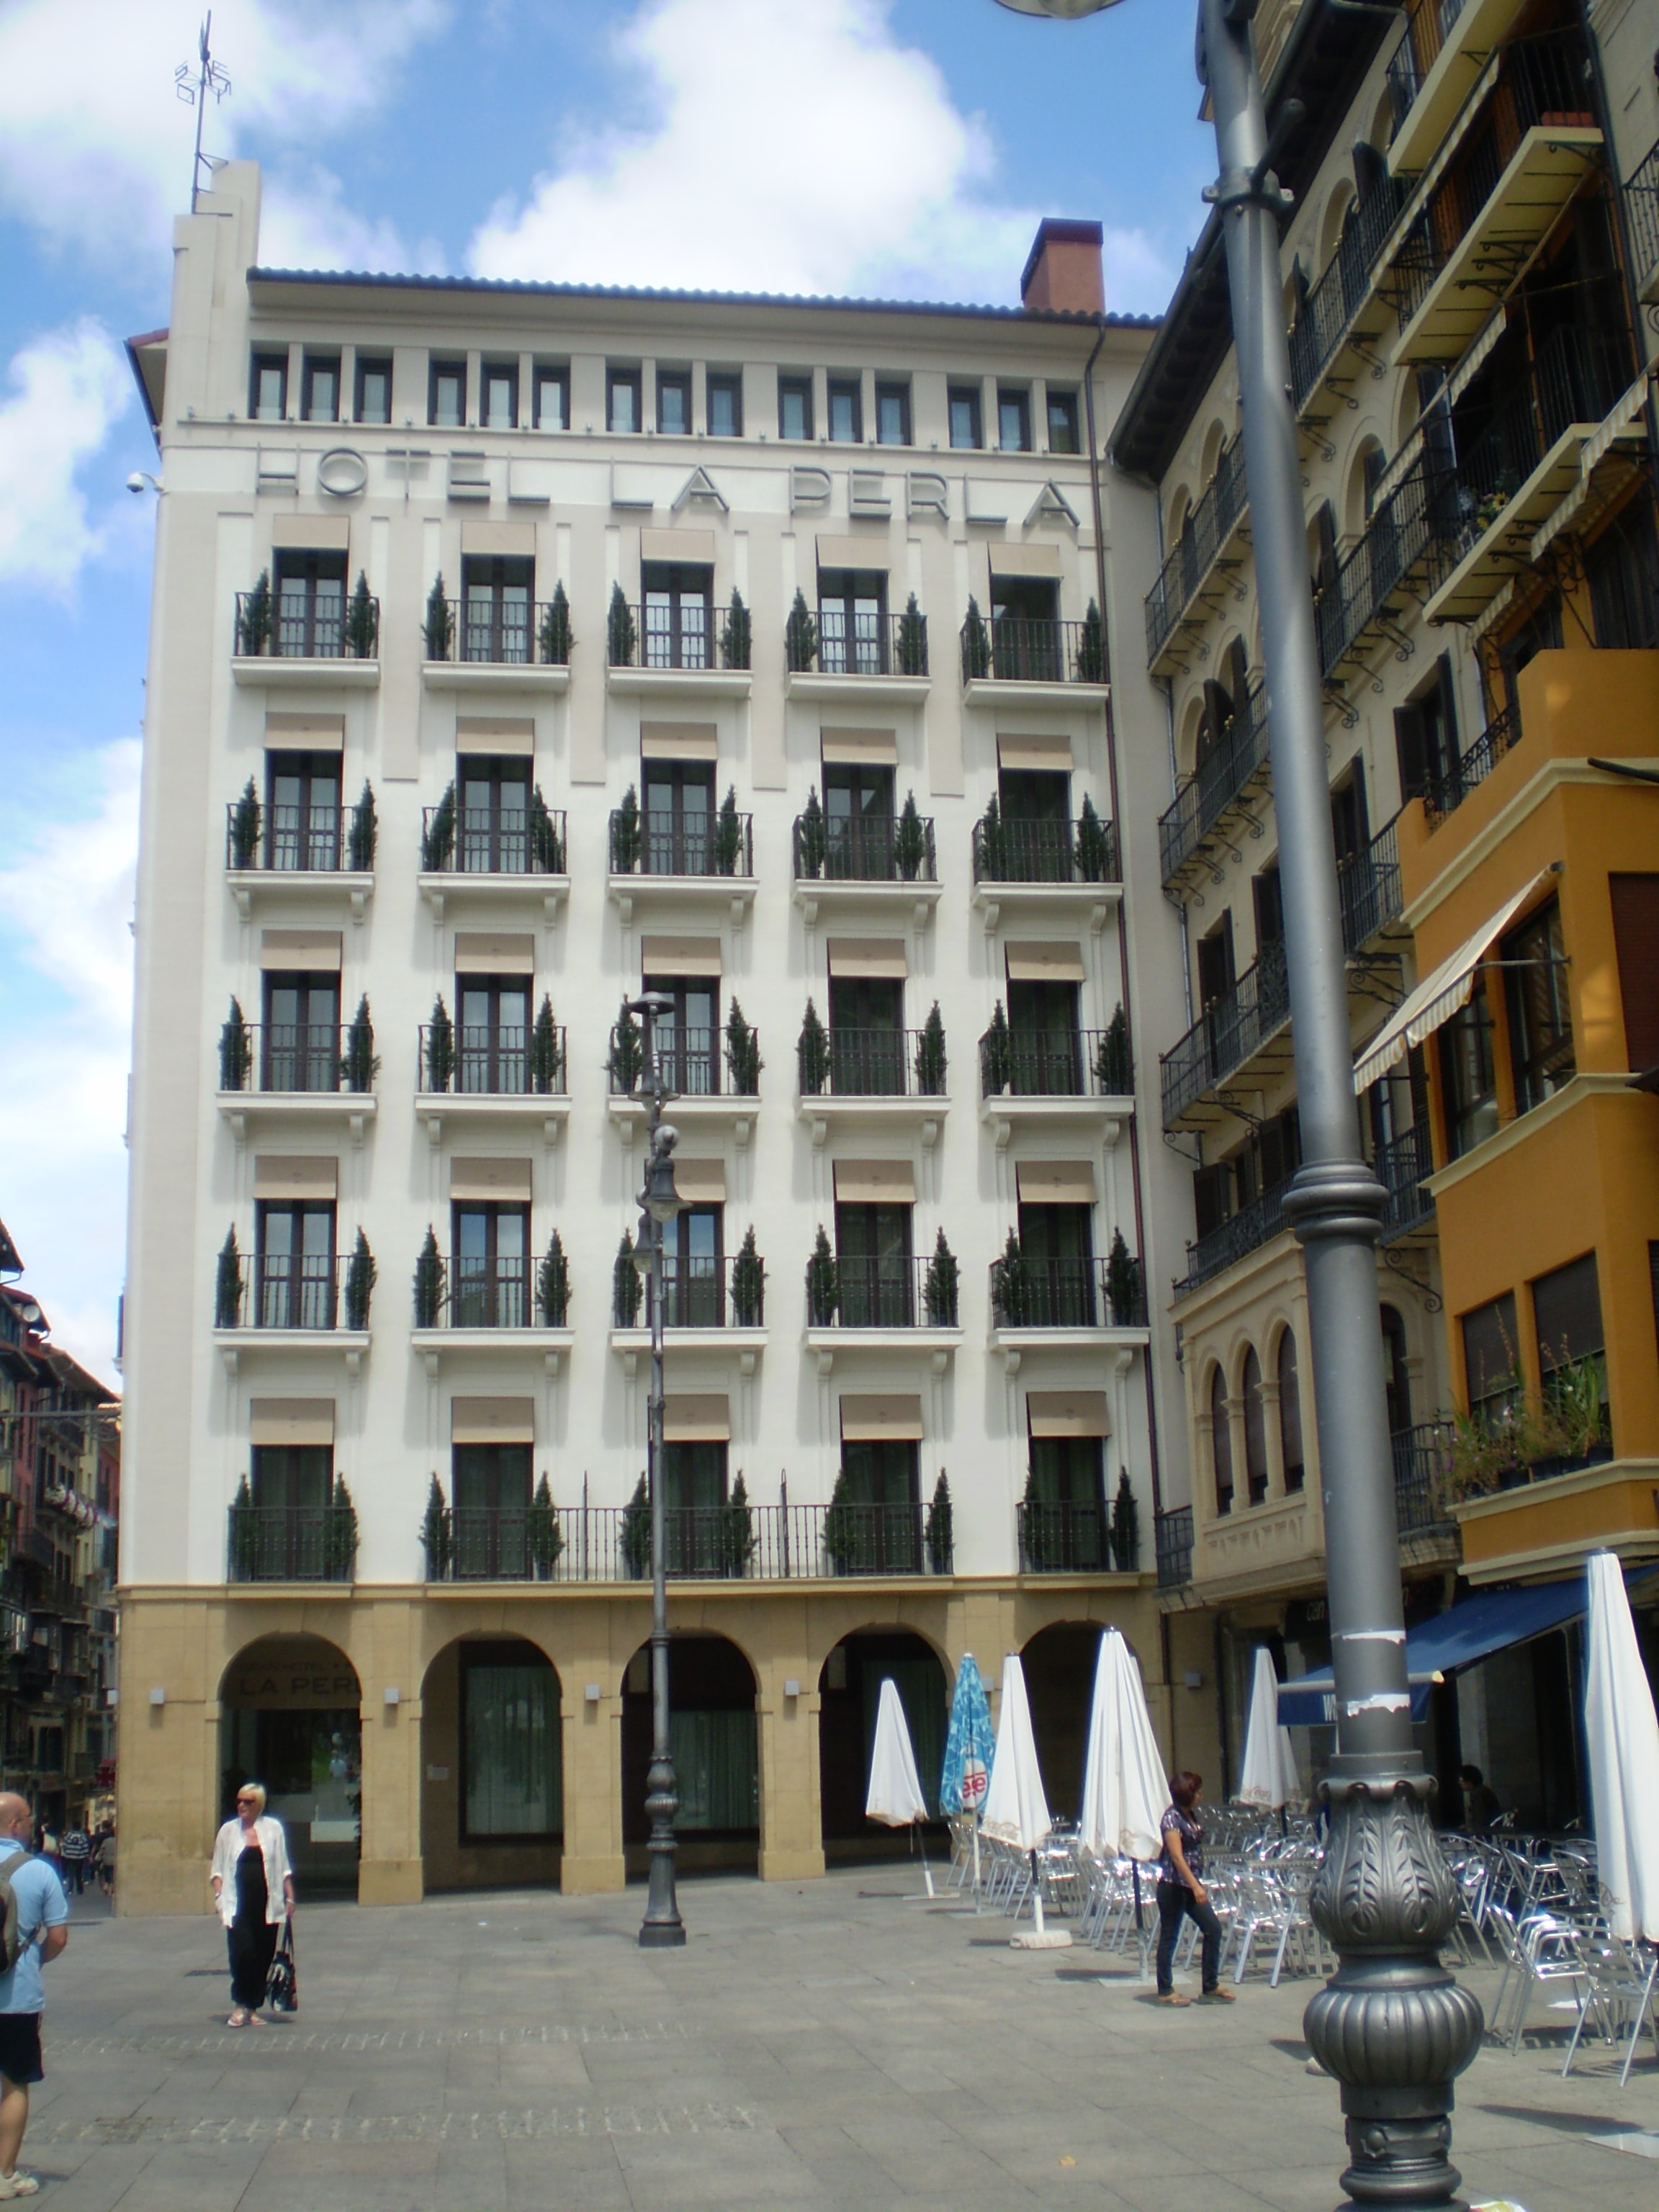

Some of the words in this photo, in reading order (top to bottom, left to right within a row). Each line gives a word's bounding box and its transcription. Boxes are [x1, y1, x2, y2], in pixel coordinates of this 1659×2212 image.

[256, 443, 551, 503] HOTEL
[611, 457, 730, 512] LA
[789, 464, 1080, 527] PERLA
[240, 1677, 278, 1696] LA
